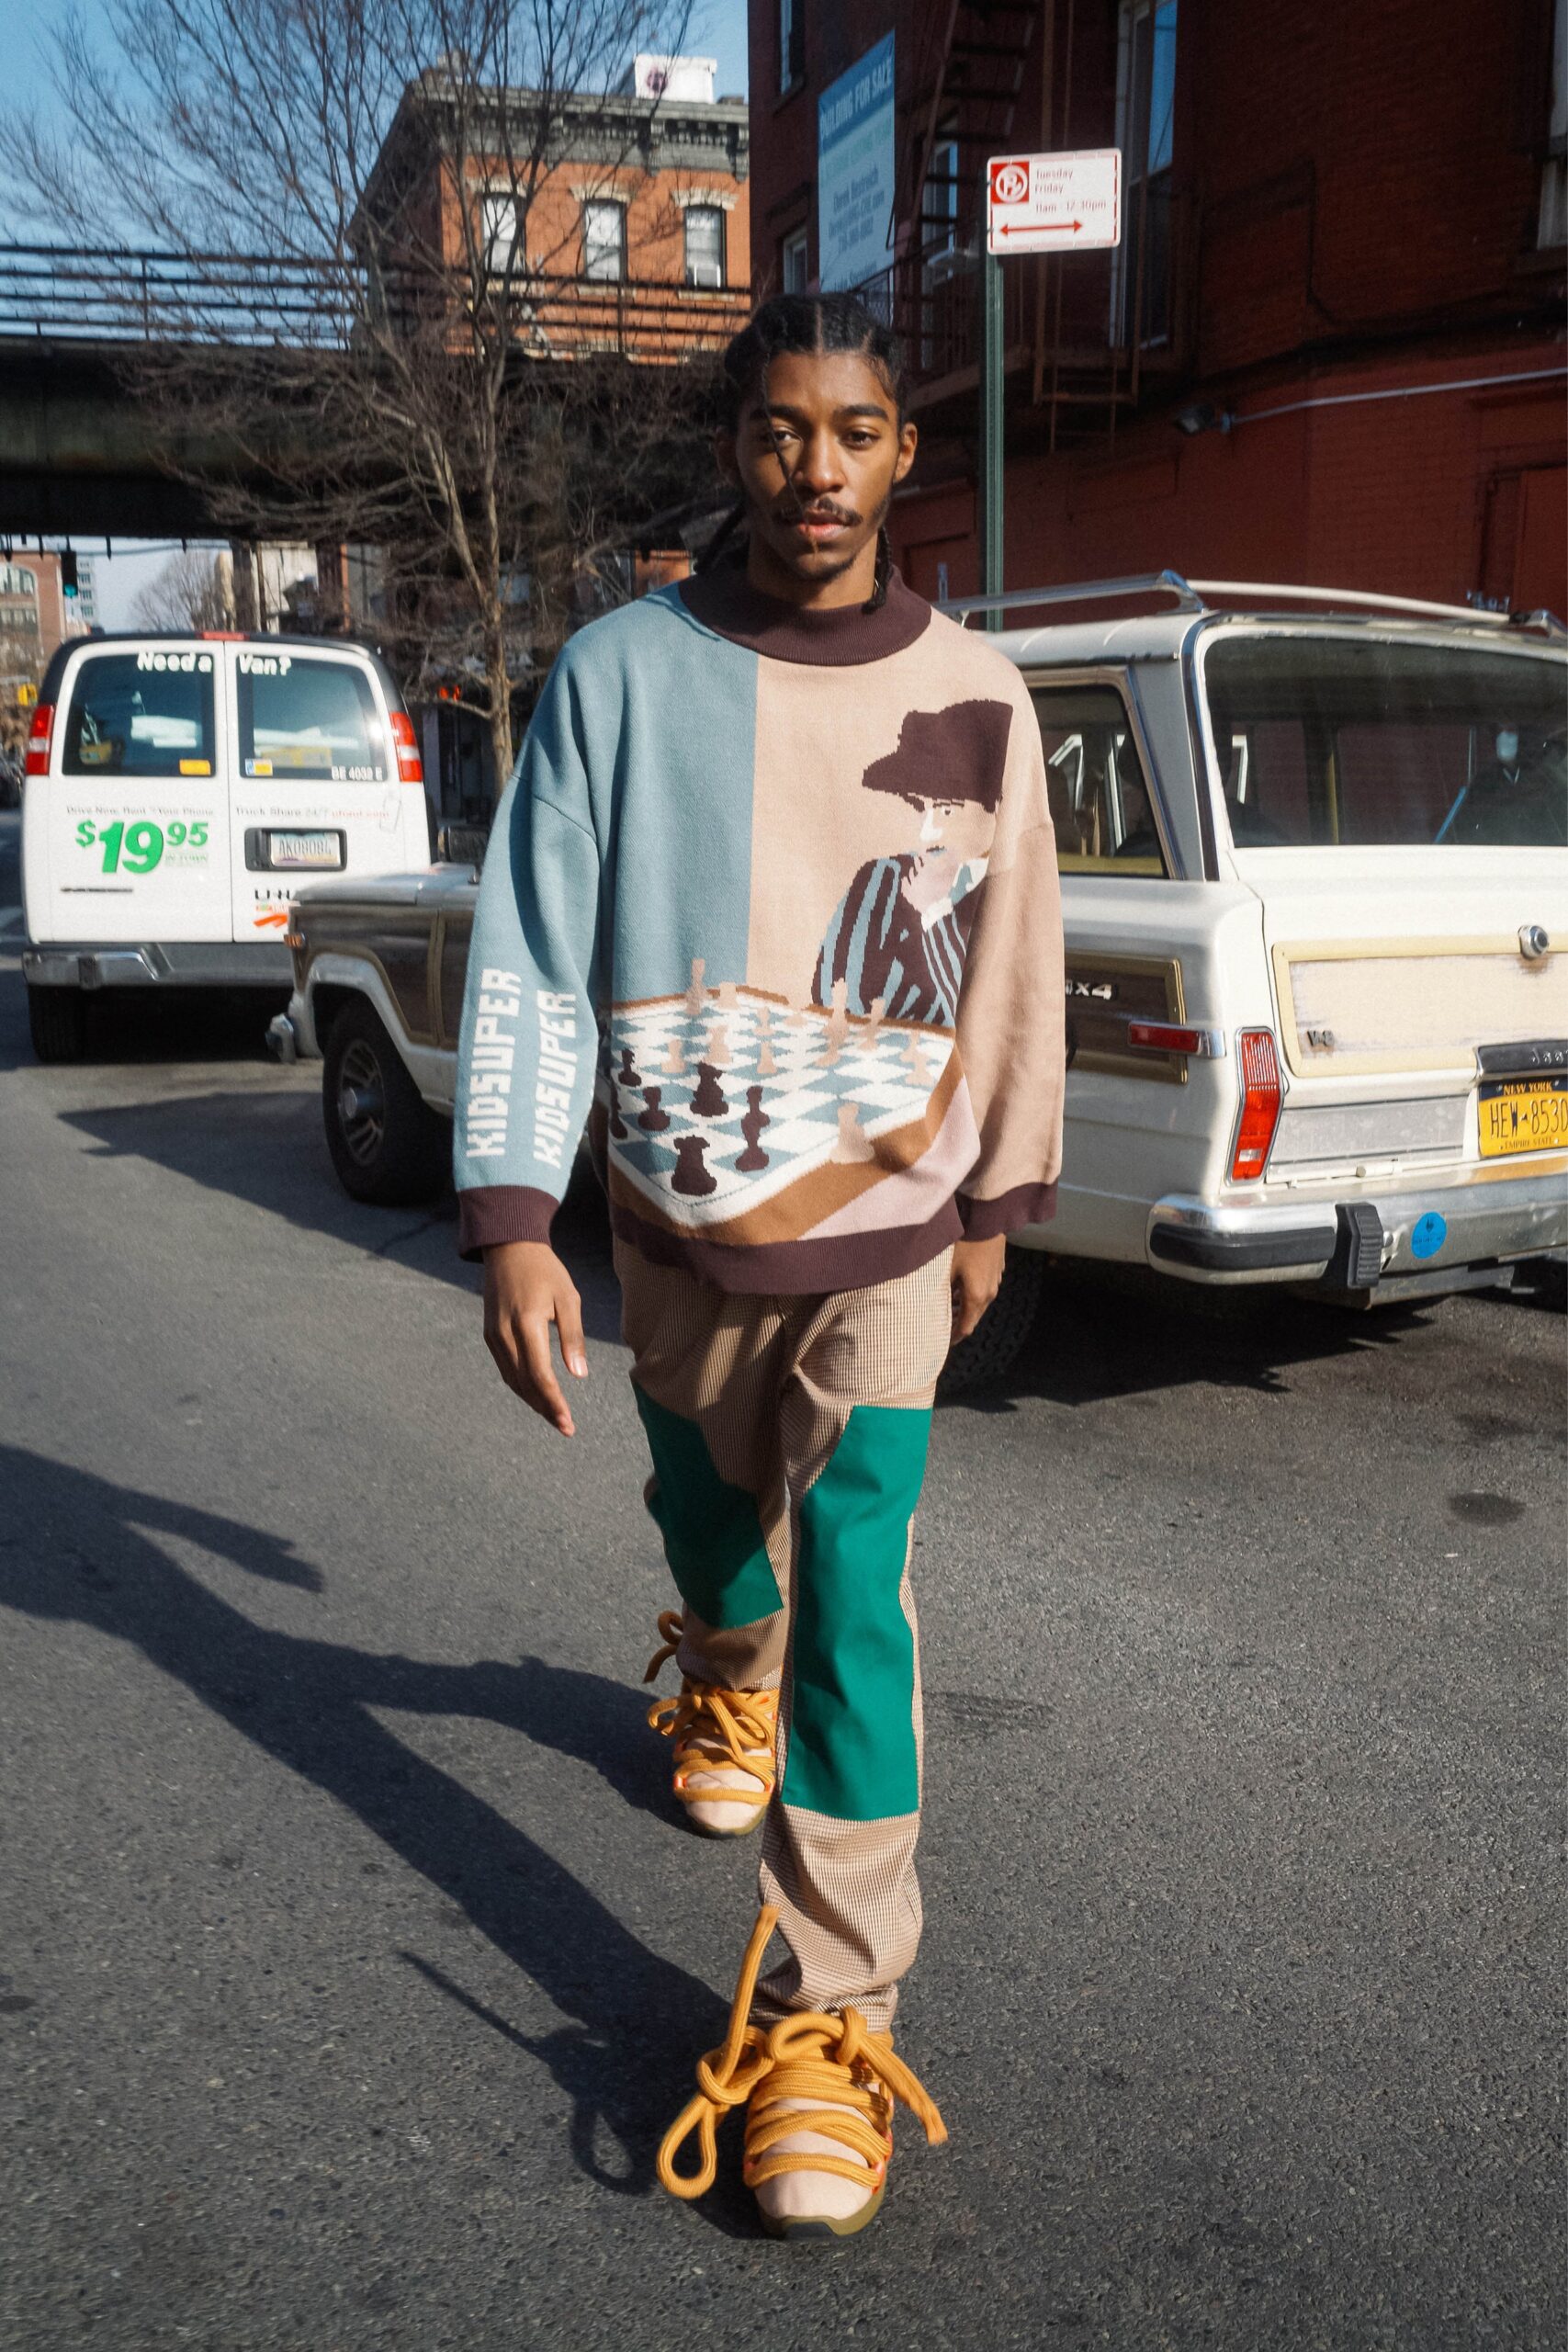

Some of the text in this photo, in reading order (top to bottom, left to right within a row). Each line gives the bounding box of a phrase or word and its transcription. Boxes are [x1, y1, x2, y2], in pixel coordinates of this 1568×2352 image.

[854, 74, 870, 113] FOR
[872, 57, 892, 98] SALE
[1036, 168, 1073, 180] Tuesday
[1035, 183, 1064, 196] Friday
[137, 652, 291, 675] Need a Van?
[236, 806, 267, 817] Truck
[270, 807, 301, 817] Share
[466, 968, 522, 1158] KIDSUPER
[533, 989, 577, 1170] KIDSUPER
[1504, 1081, 1552, 1095] NEW YORK
